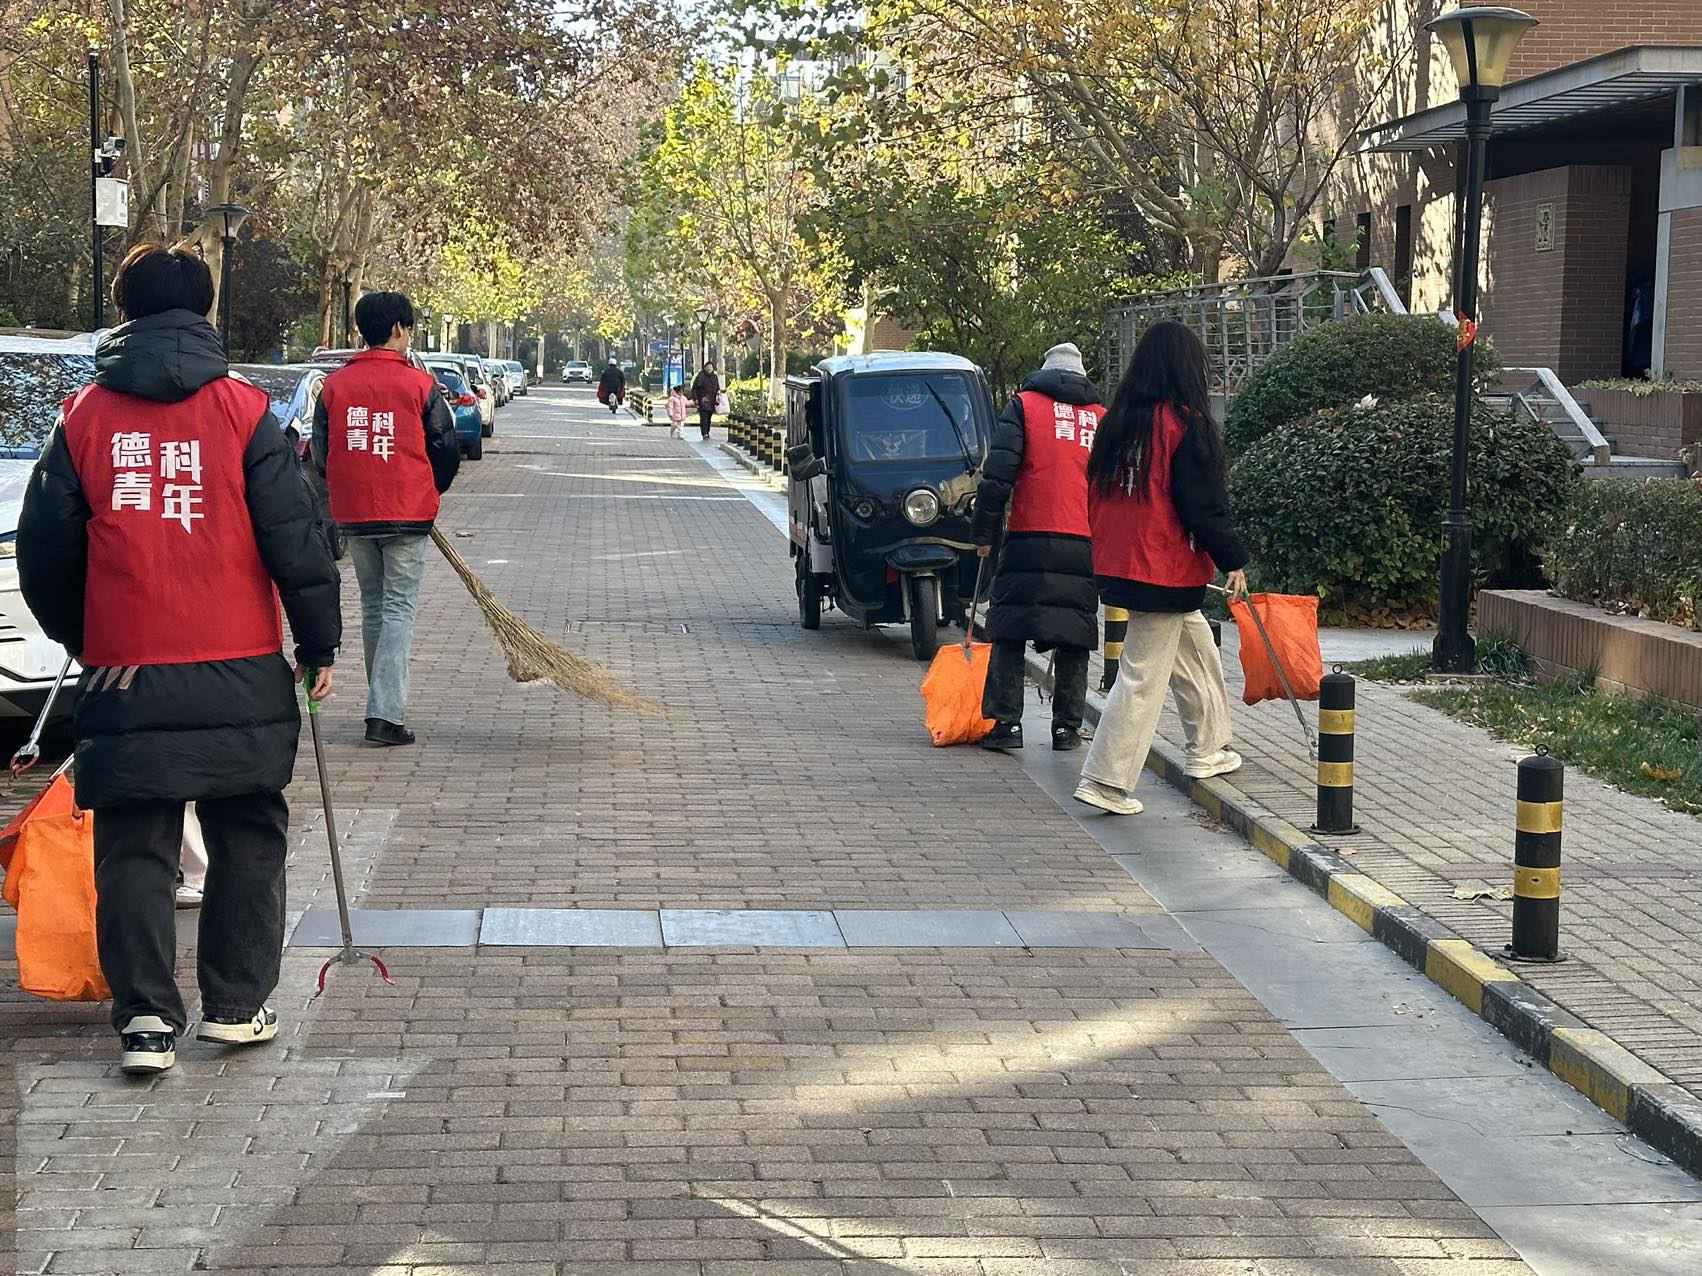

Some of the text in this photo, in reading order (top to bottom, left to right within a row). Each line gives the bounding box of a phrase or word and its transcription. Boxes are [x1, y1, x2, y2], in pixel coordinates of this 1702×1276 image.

[346, 406, 395, 435] 德科
[1053, 401, 1098, 430] 德科
[110, 431, 203, 485] 德科
[346, 428, 395, 463] 青年
[111, 471, 205, 536] 青年
